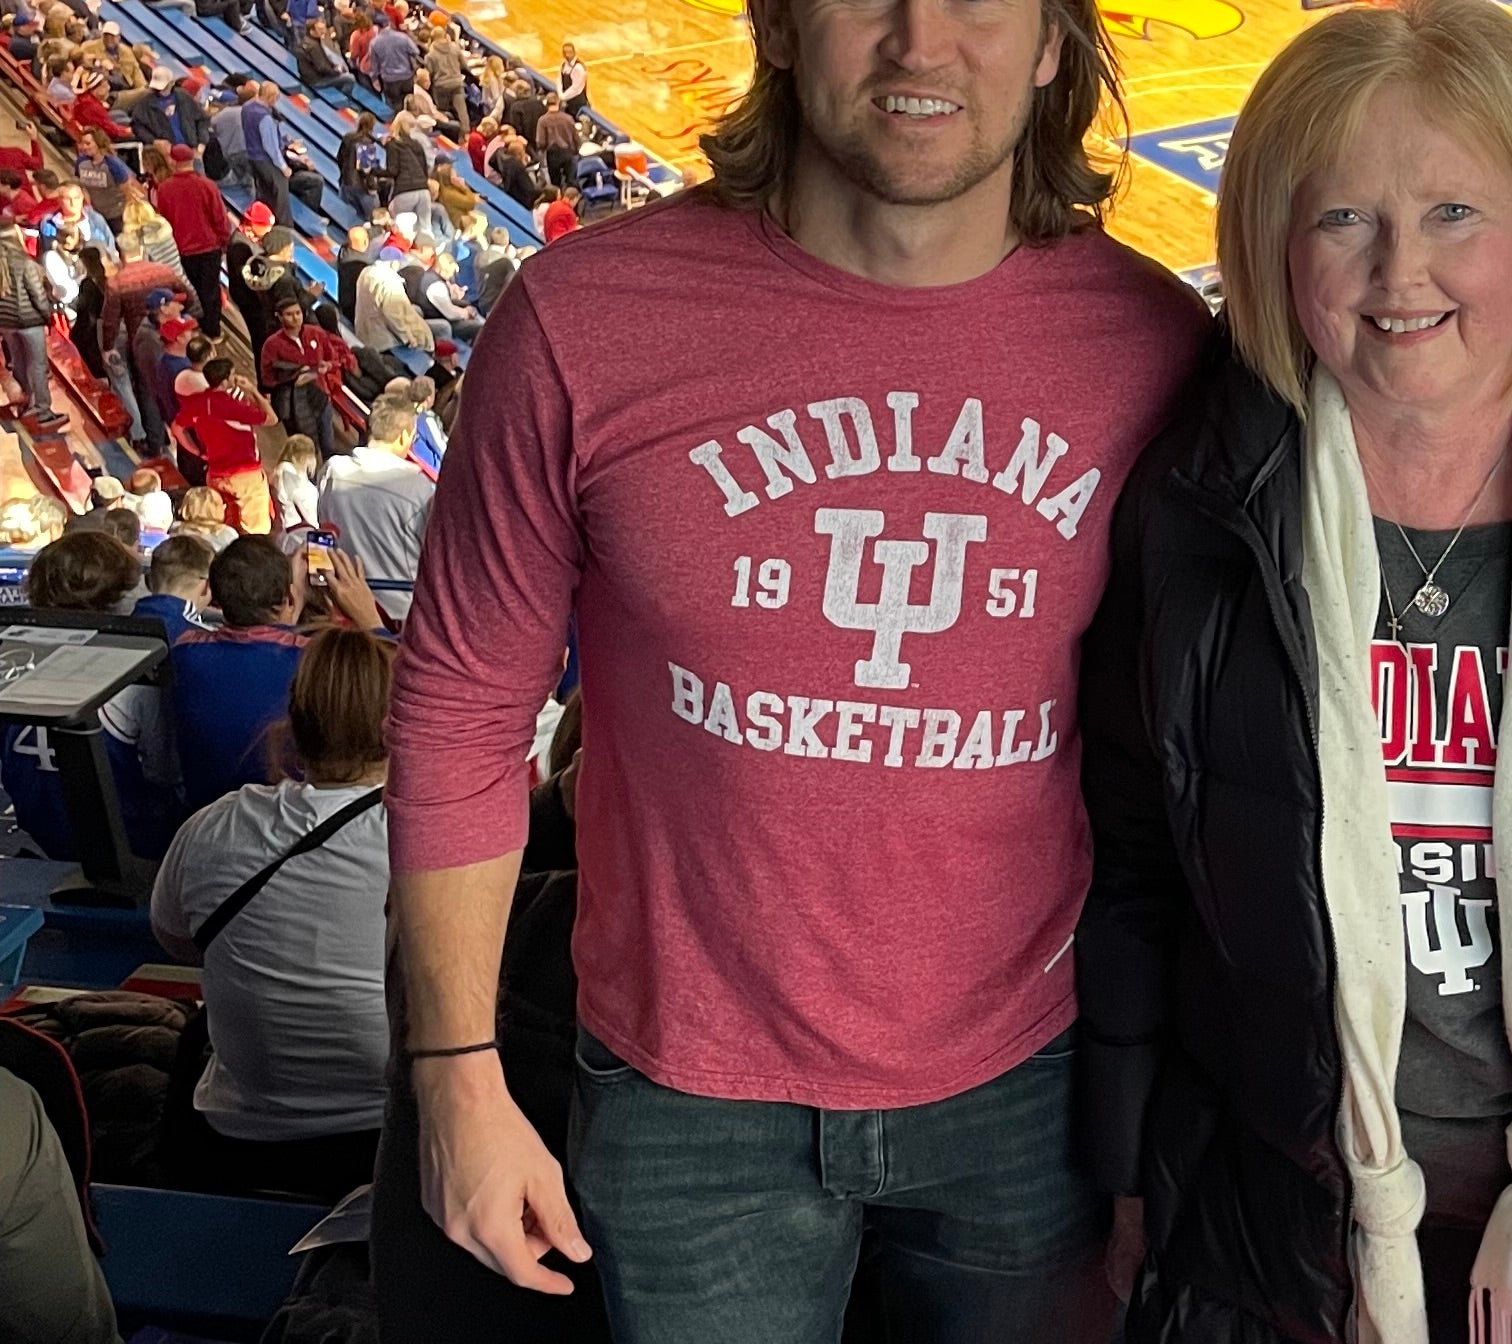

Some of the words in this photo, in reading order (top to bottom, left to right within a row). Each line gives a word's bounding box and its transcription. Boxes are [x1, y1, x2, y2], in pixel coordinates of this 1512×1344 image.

[689, 391, 1101, 541] INDIANA
[730, 555, 792, 609] 19
[814, 506, 988, 690] IU
[986, 568, 1039, 618] 51
[12, 725, 60, 774] 4
[667, 660, 1058, 770] BASKETBALL
